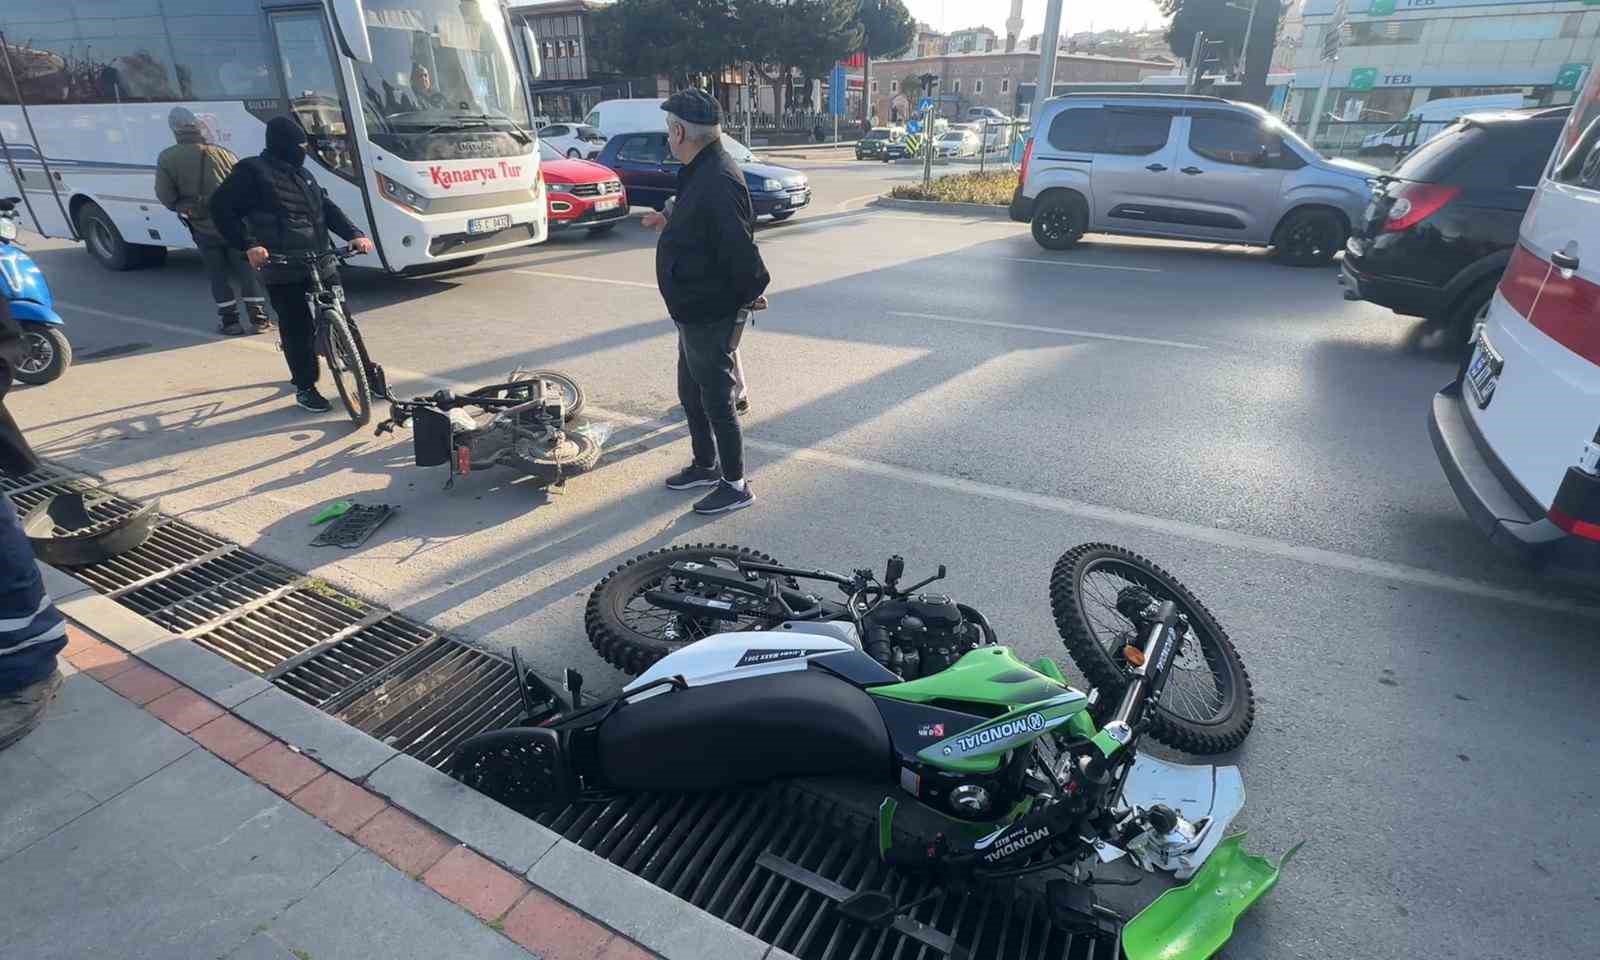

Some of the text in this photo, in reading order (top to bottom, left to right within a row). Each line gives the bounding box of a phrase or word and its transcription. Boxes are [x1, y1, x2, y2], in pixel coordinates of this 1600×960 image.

[1383, 74, 1412, 86] TEB
[430, 160, 522, 189] Kanarya Tur
[957, 718, 1027, 751] MONDIAL
[984, 826, 1050, 862] MONDIAL
